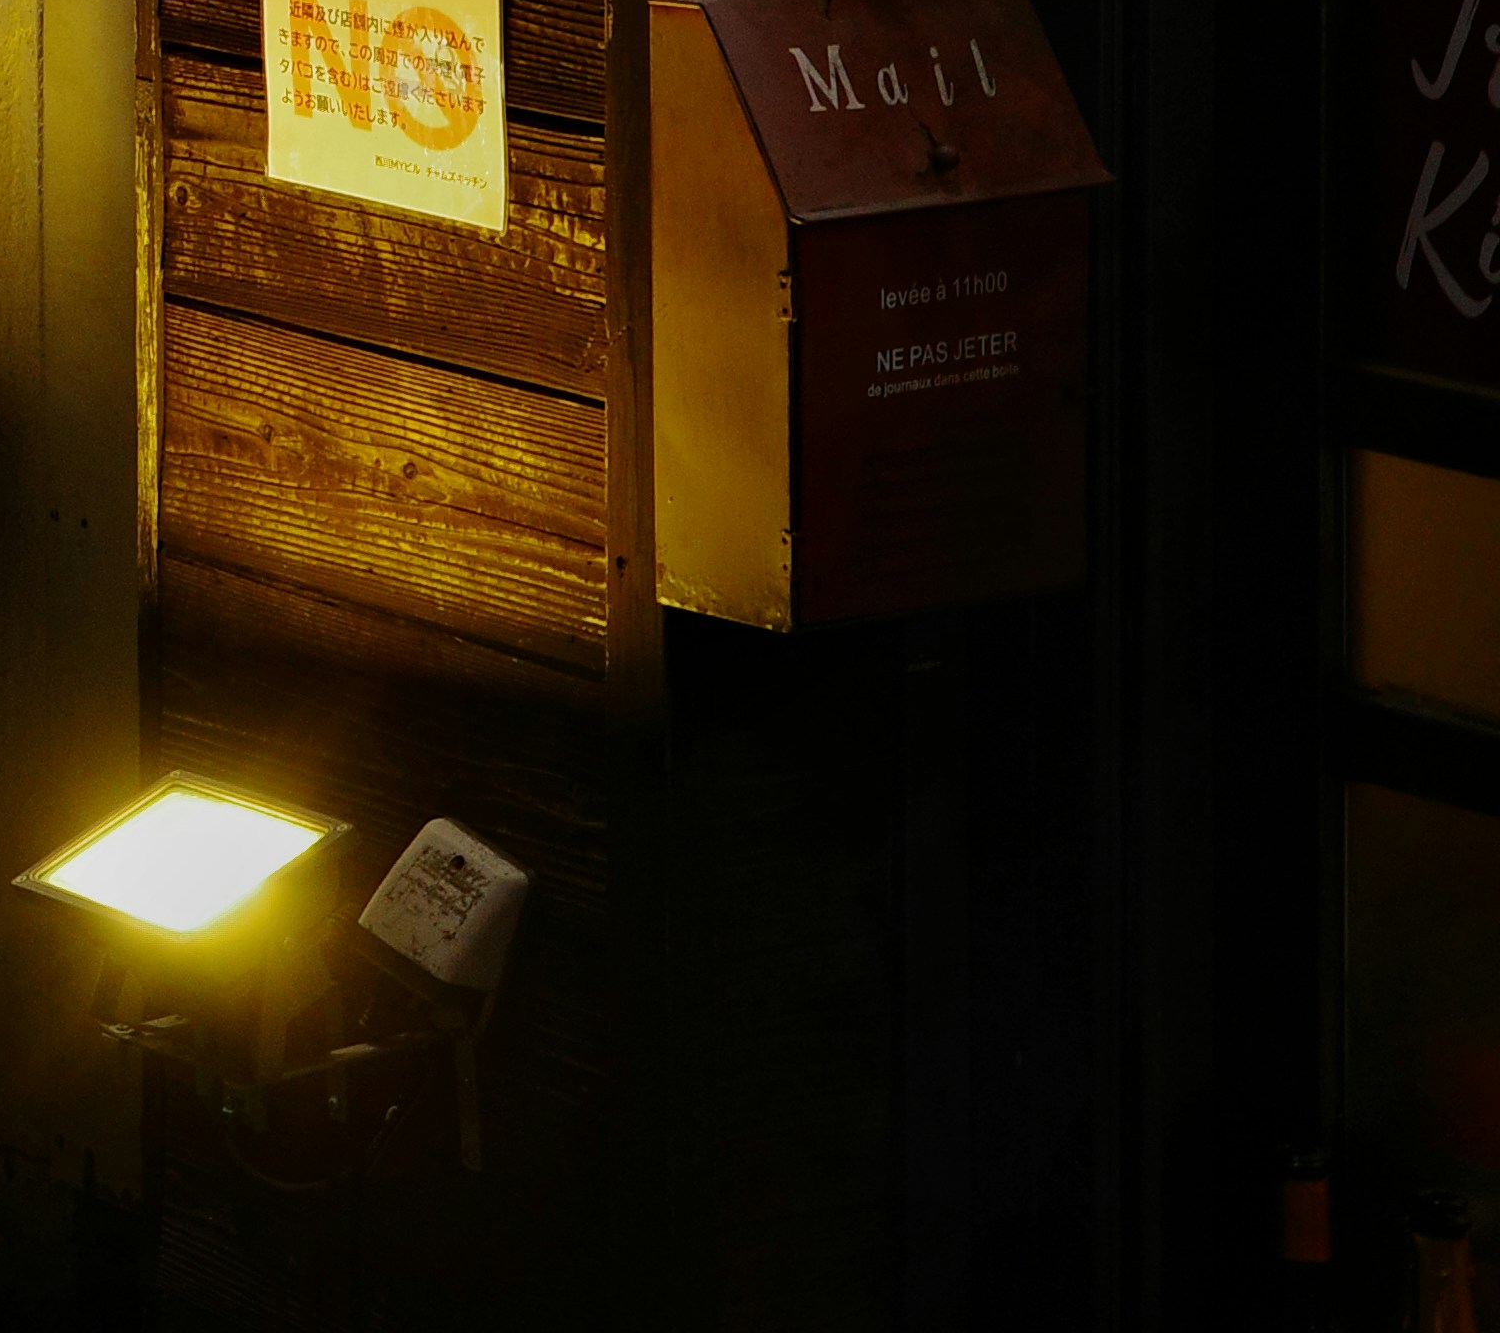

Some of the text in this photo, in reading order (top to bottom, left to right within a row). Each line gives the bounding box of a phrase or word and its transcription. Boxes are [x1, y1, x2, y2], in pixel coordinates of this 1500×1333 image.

[788, 39, 996, 113] Mail
[880, 271, 1008, 311] levée à 11h00
[876, 331, 1018, 374] NE PAS JETER
[867, 382, 882, 397] de
[883, 374, 932, 397] journaux
[934, 370, 961, 389] dans
